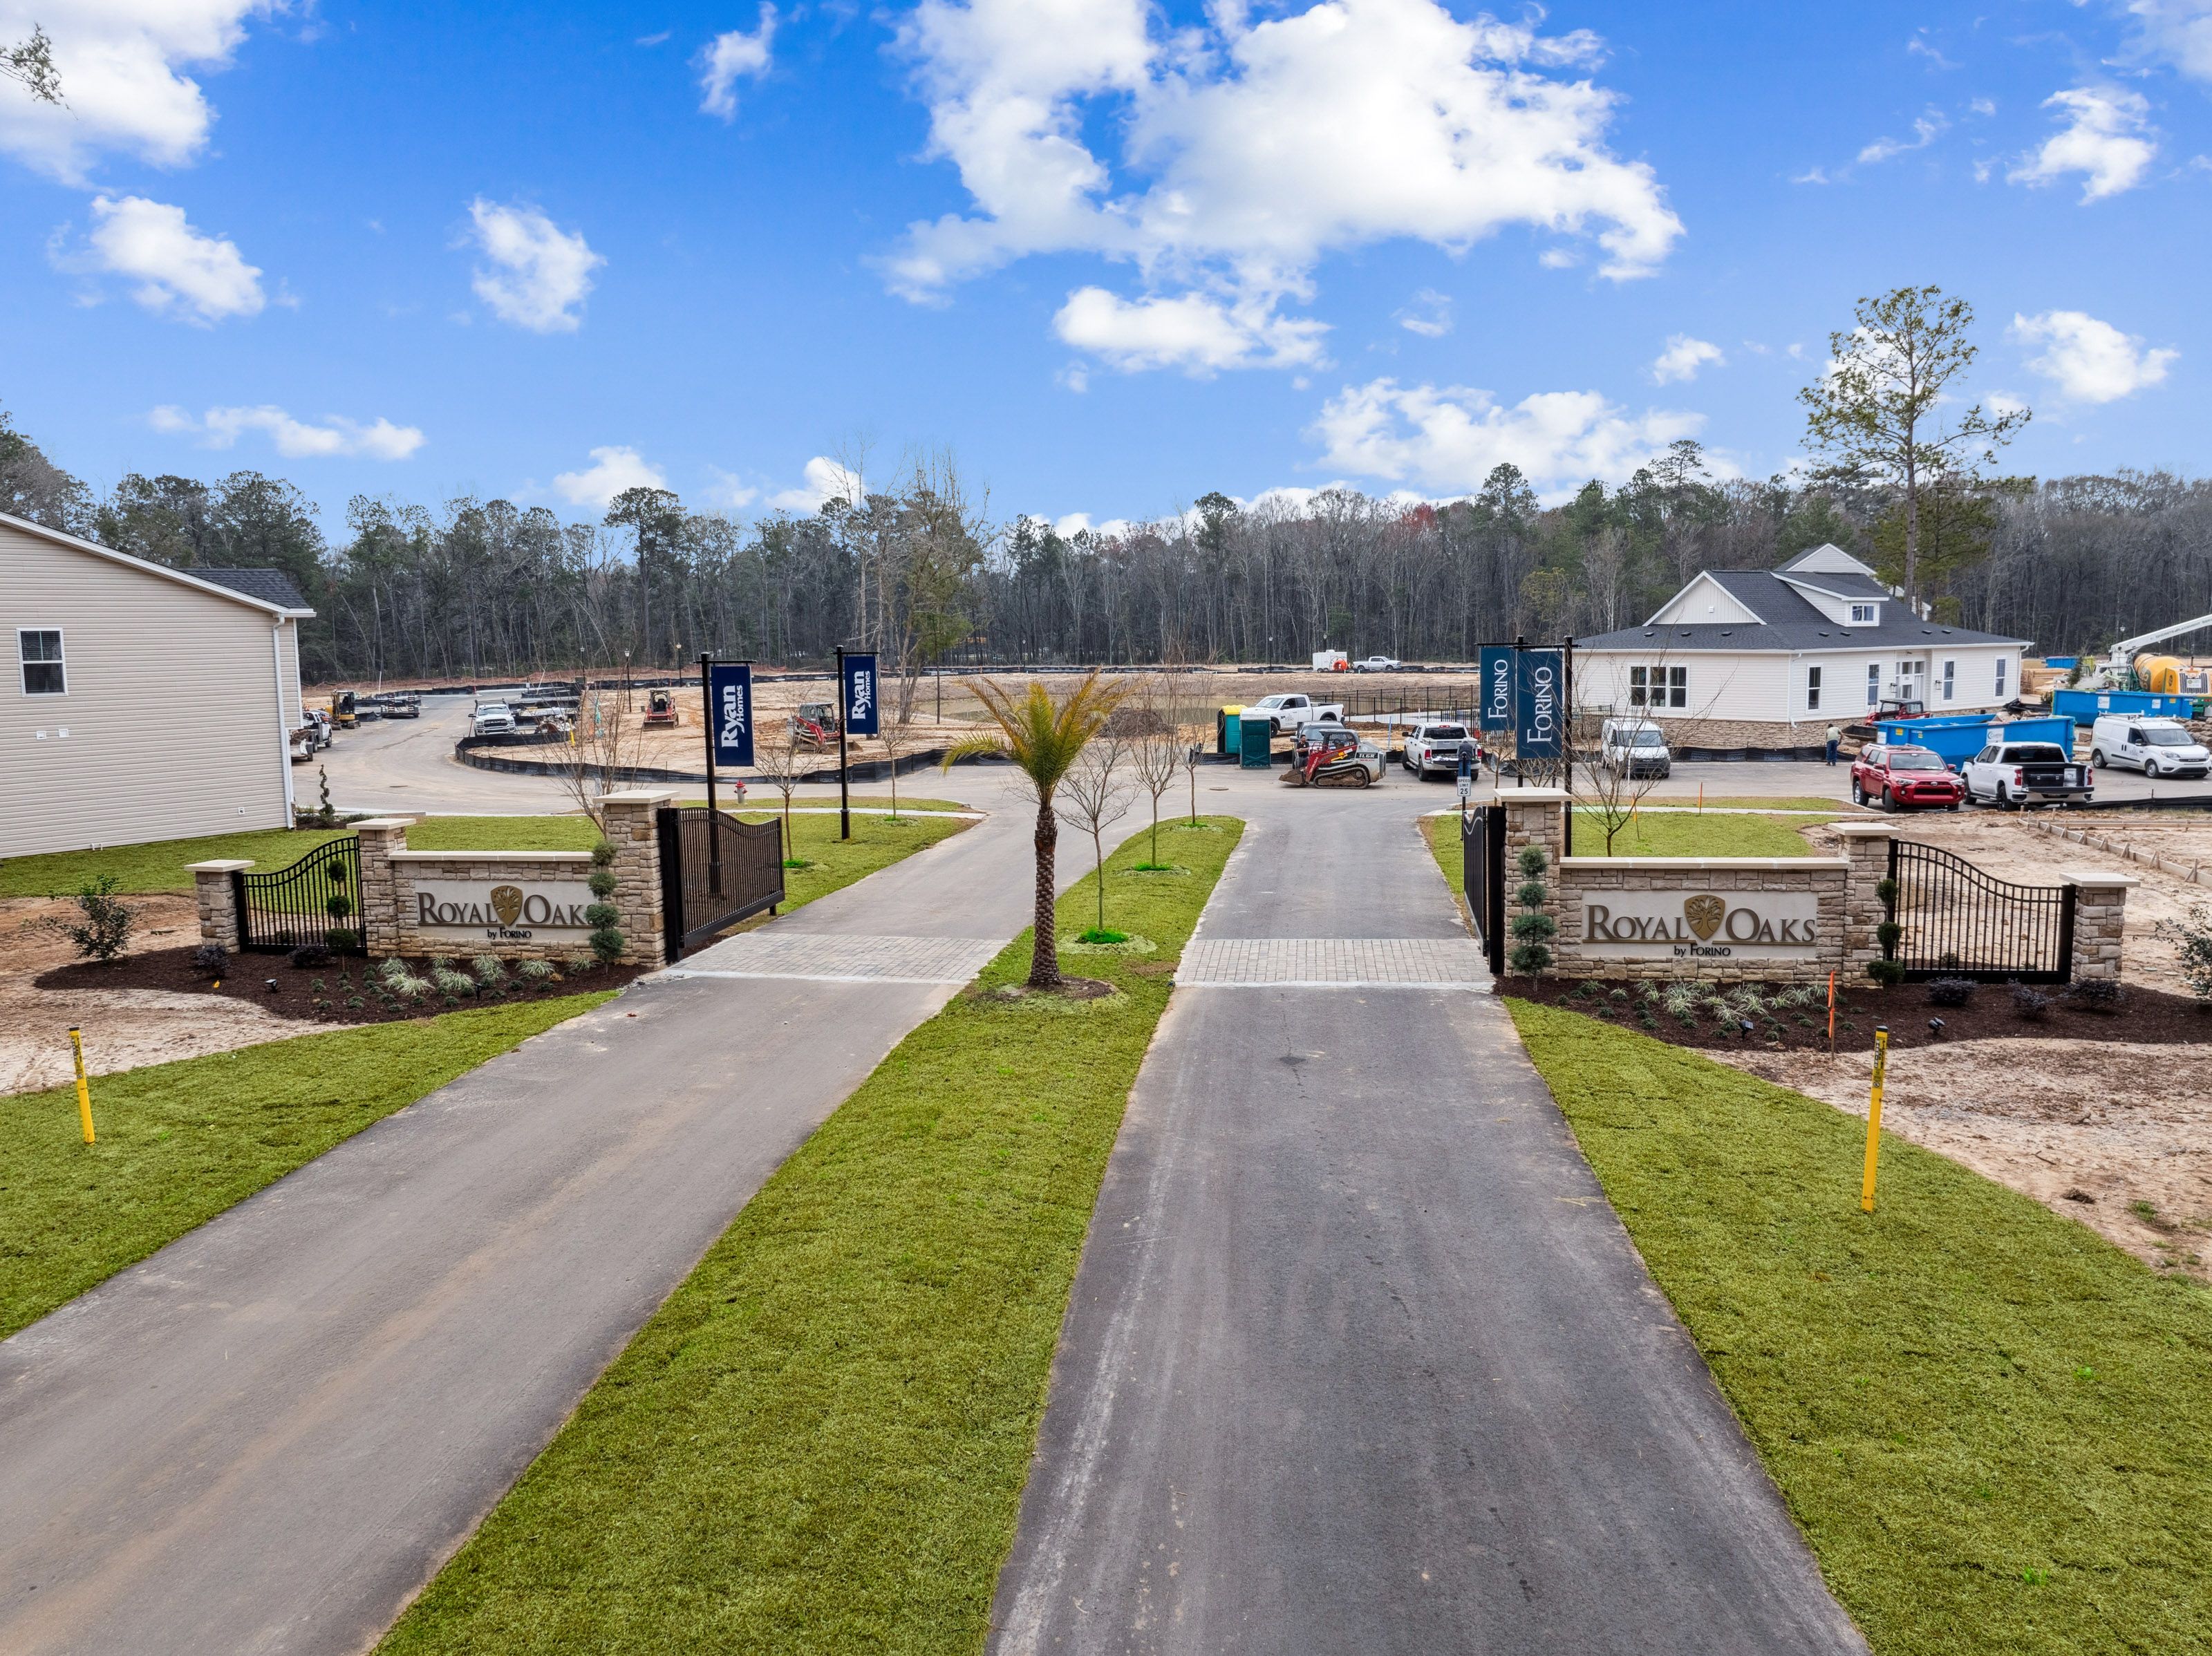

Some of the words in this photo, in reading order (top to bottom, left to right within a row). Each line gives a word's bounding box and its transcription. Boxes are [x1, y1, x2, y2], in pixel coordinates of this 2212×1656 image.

[736, 684, 744, 722] Homes
[852, 670, 872, 719] Ryan
[1488, 659, 1508, 719] FORINO
[1526, 666, 1553, 743] FORINO
[721, 685, 745, 748] Ryan
[417, 892, 498, 923] ROYAL
[523, 894, 596, 925] OAK
[1585, 904, 1689, 940] ROYAL
[1725, 907, 1816, 942] OAKS
[487, 929, 497, 940] by
[499, 927, 532, 939] FORINO
[1674, 945, 1686, 958] by
[1690, 943, 1731, 956] FORINO
